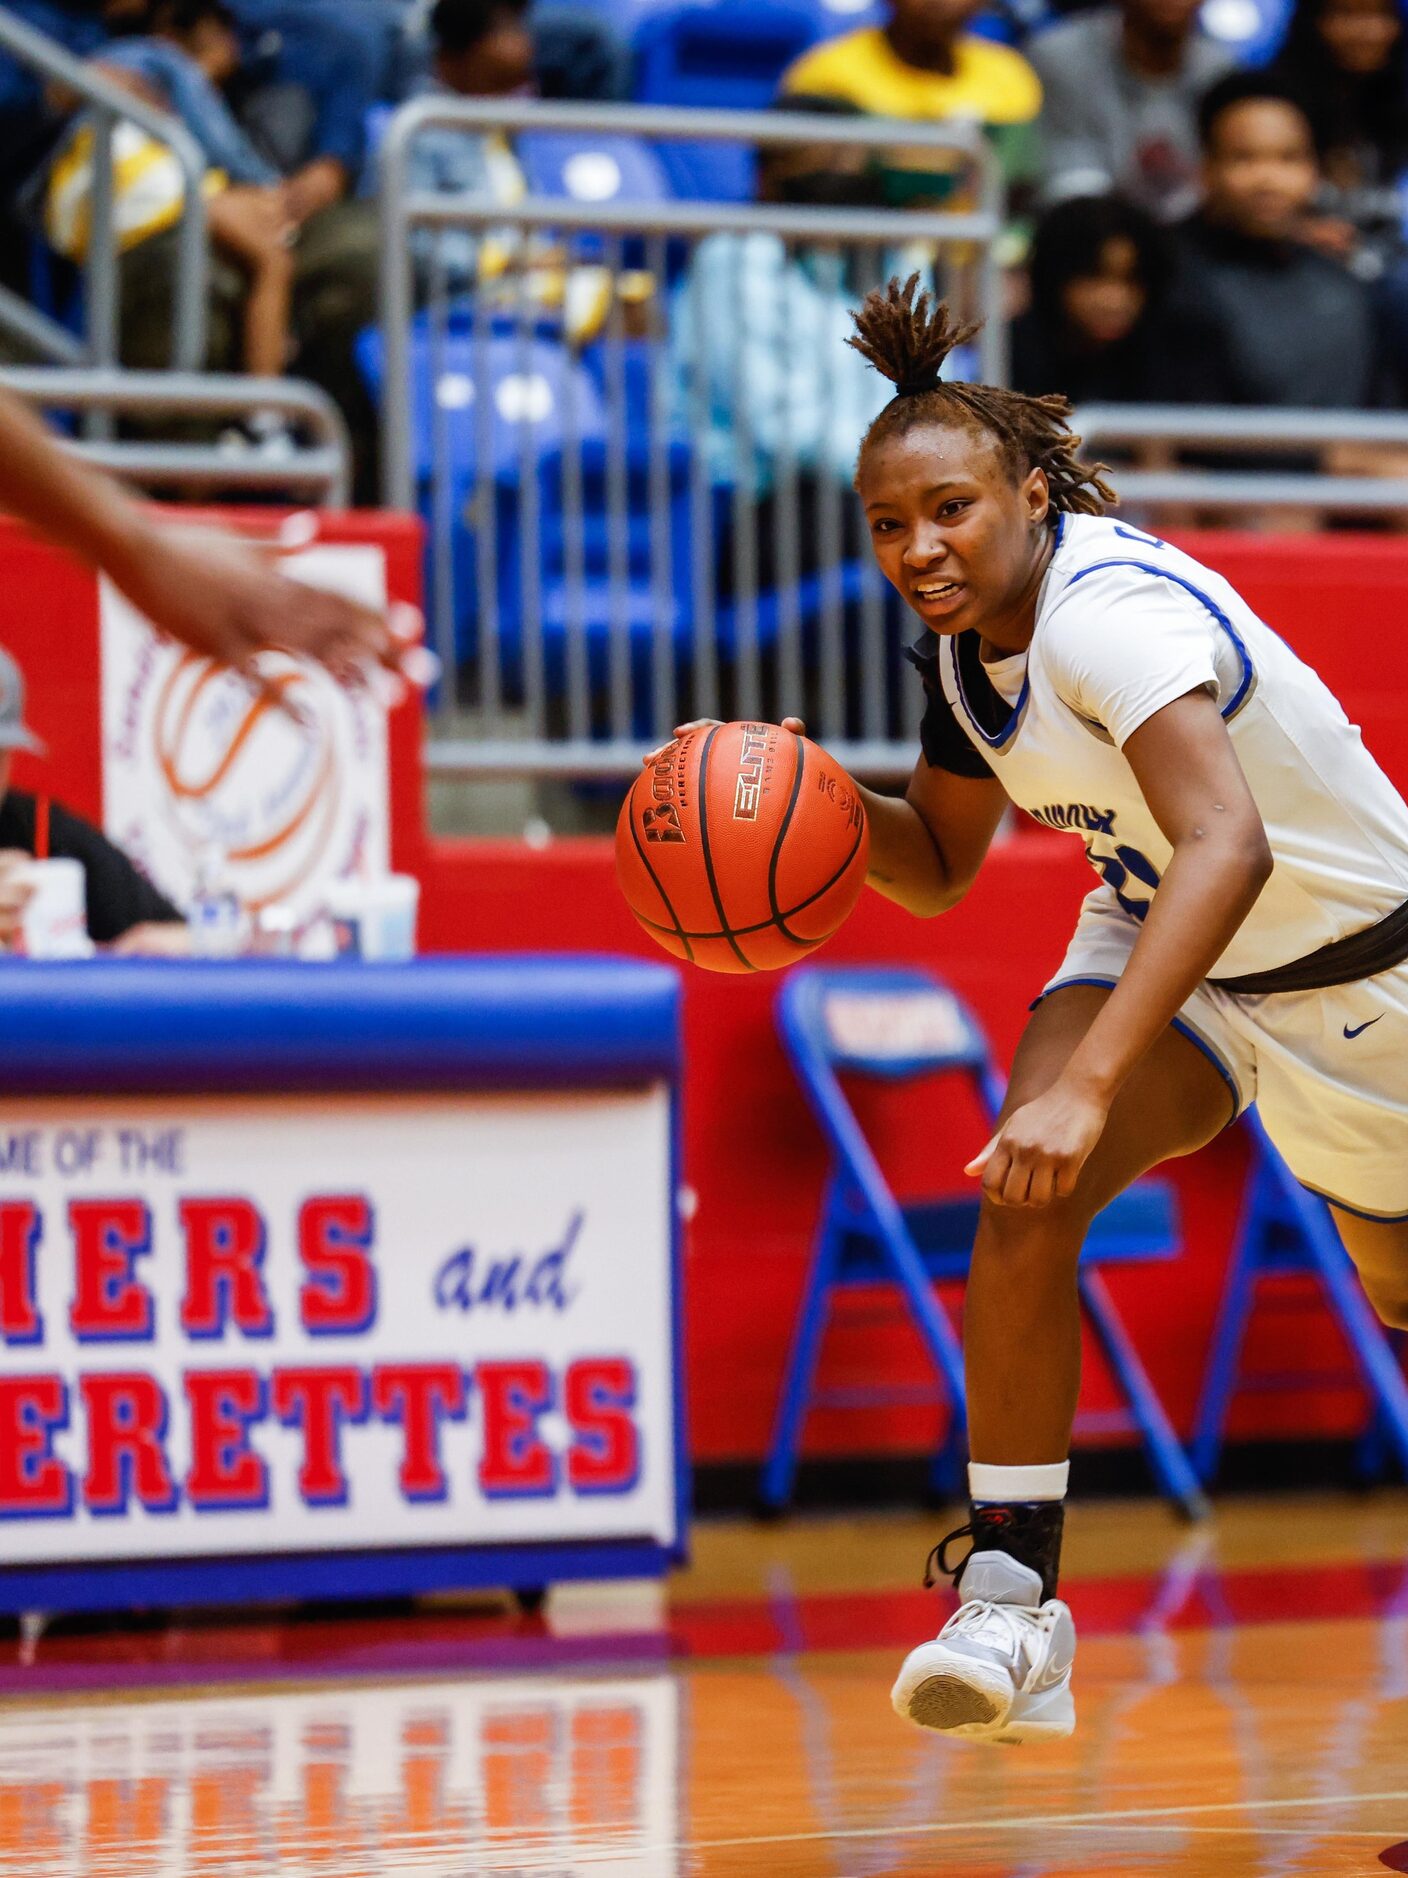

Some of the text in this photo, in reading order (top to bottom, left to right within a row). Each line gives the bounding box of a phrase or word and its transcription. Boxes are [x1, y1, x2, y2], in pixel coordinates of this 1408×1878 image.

[733, 723, 769, 822] ELITE
[54, 1130, 103, 1180] OF
[117, 1129, 186, 1180] THE
[432, 1205, 585, 1317] and
[0, 1355, 643, 1520] ERETTES
